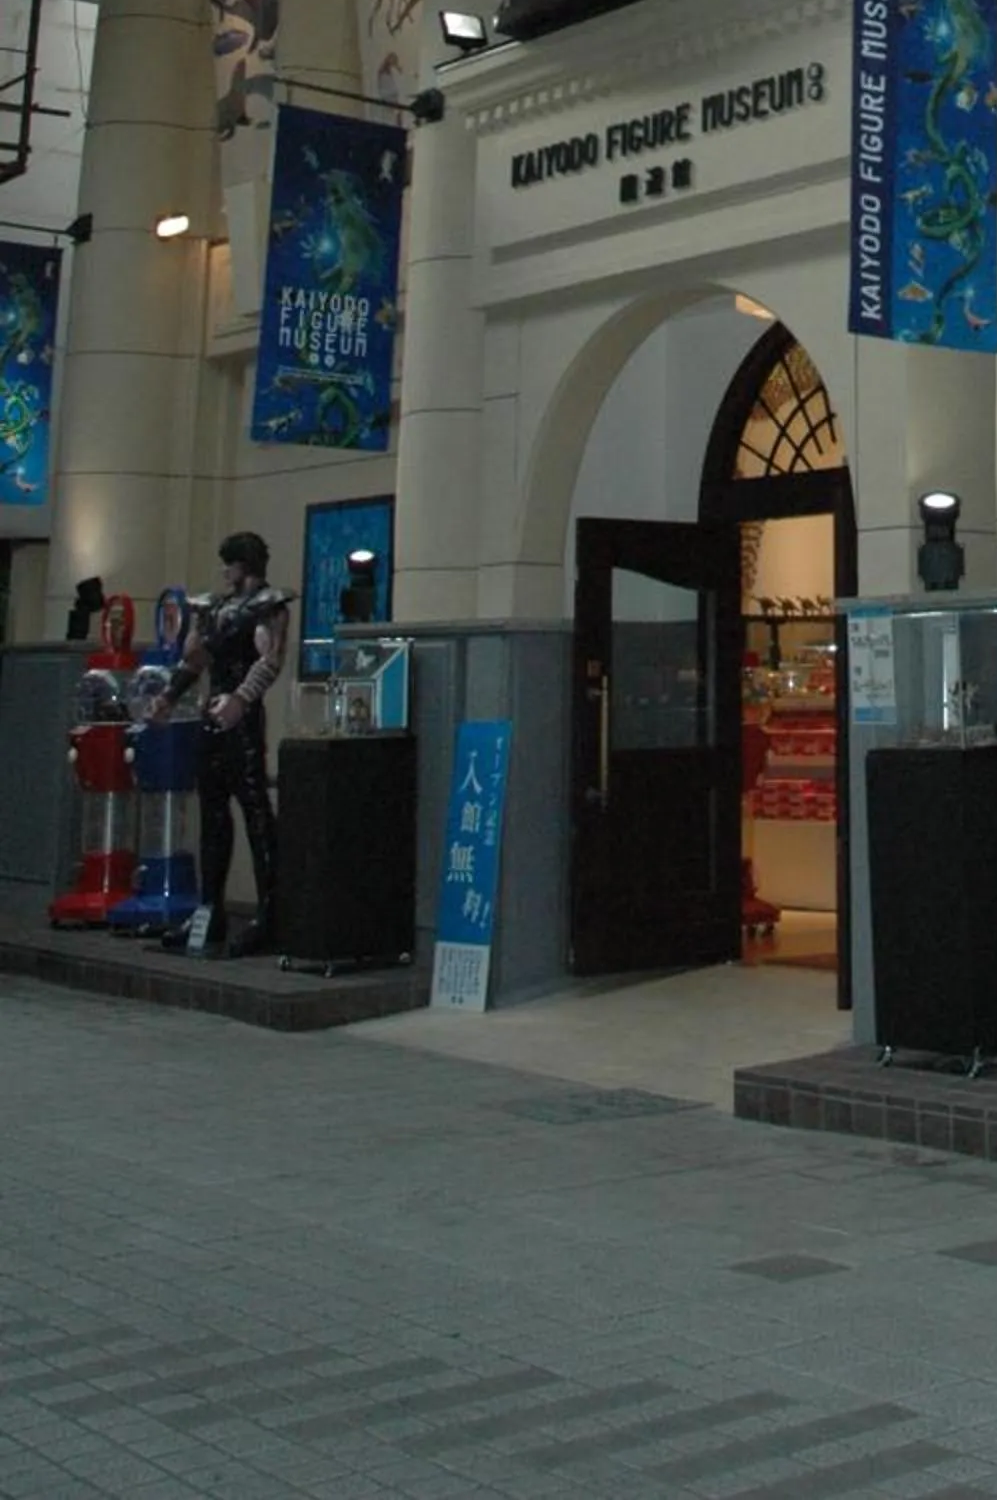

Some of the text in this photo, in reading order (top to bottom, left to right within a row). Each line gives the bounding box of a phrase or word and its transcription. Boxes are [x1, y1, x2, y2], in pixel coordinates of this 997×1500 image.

[511, 131, 598, 188] KAIYODO
[606, 103, 692, 161] FIGURE
[702, 67, 804, 132] MUSEUM
[860, 72, 886, 182] FIGURE
[281, 286, 370, 317] KAIYODO
[861, 194, 882, 322] KAIYODO
[278, 326, 367, 358] MUSEUM
